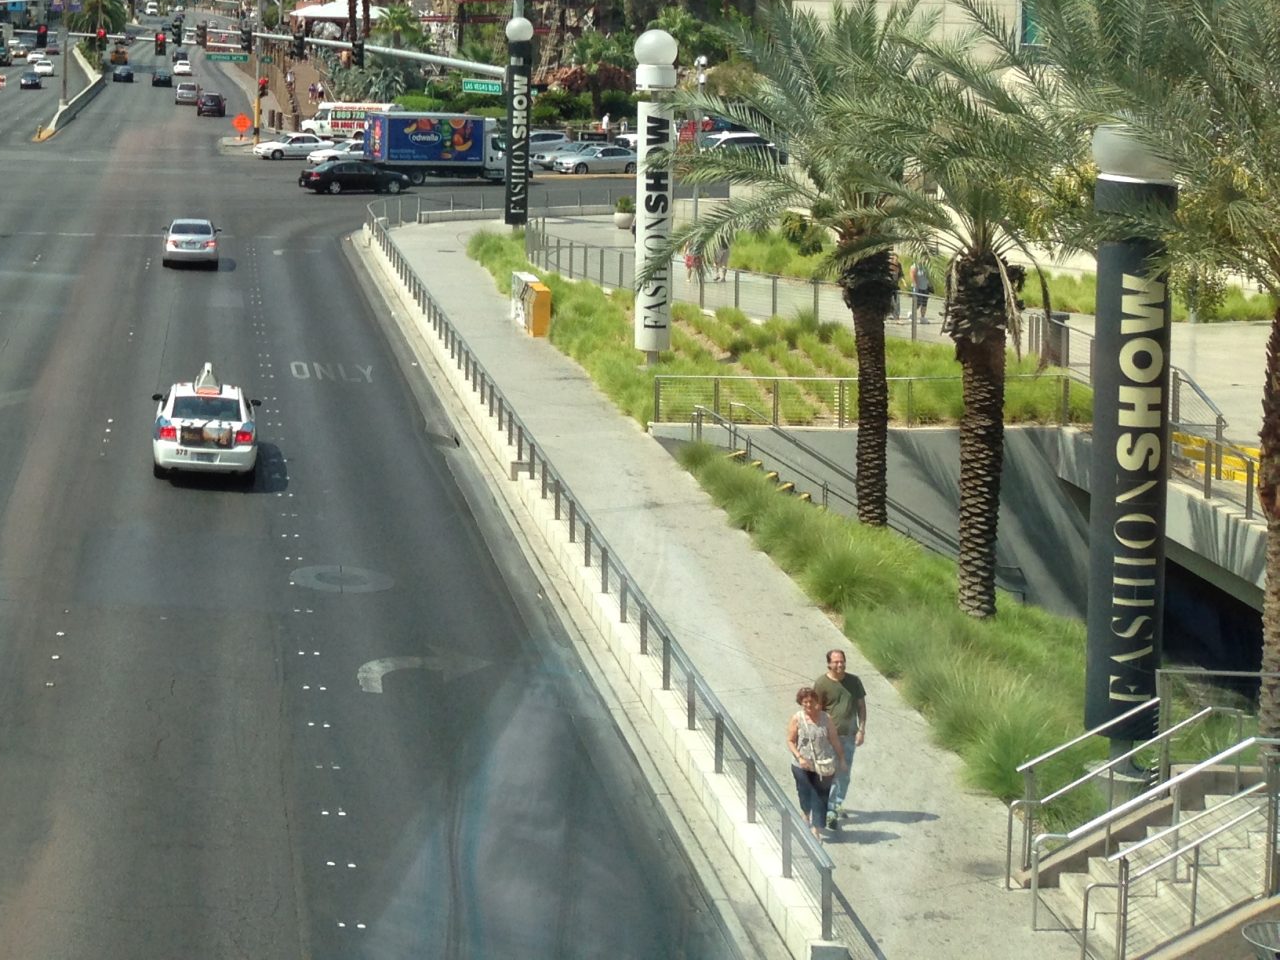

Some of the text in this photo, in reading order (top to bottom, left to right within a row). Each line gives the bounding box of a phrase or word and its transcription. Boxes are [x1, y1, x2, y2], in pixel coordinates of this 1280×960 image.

[464, 82, 500, 92] LAS VEGAS BLVD
[411, 133, 439, 142] odwalla
[290, 361, 373, 383] ONLY
